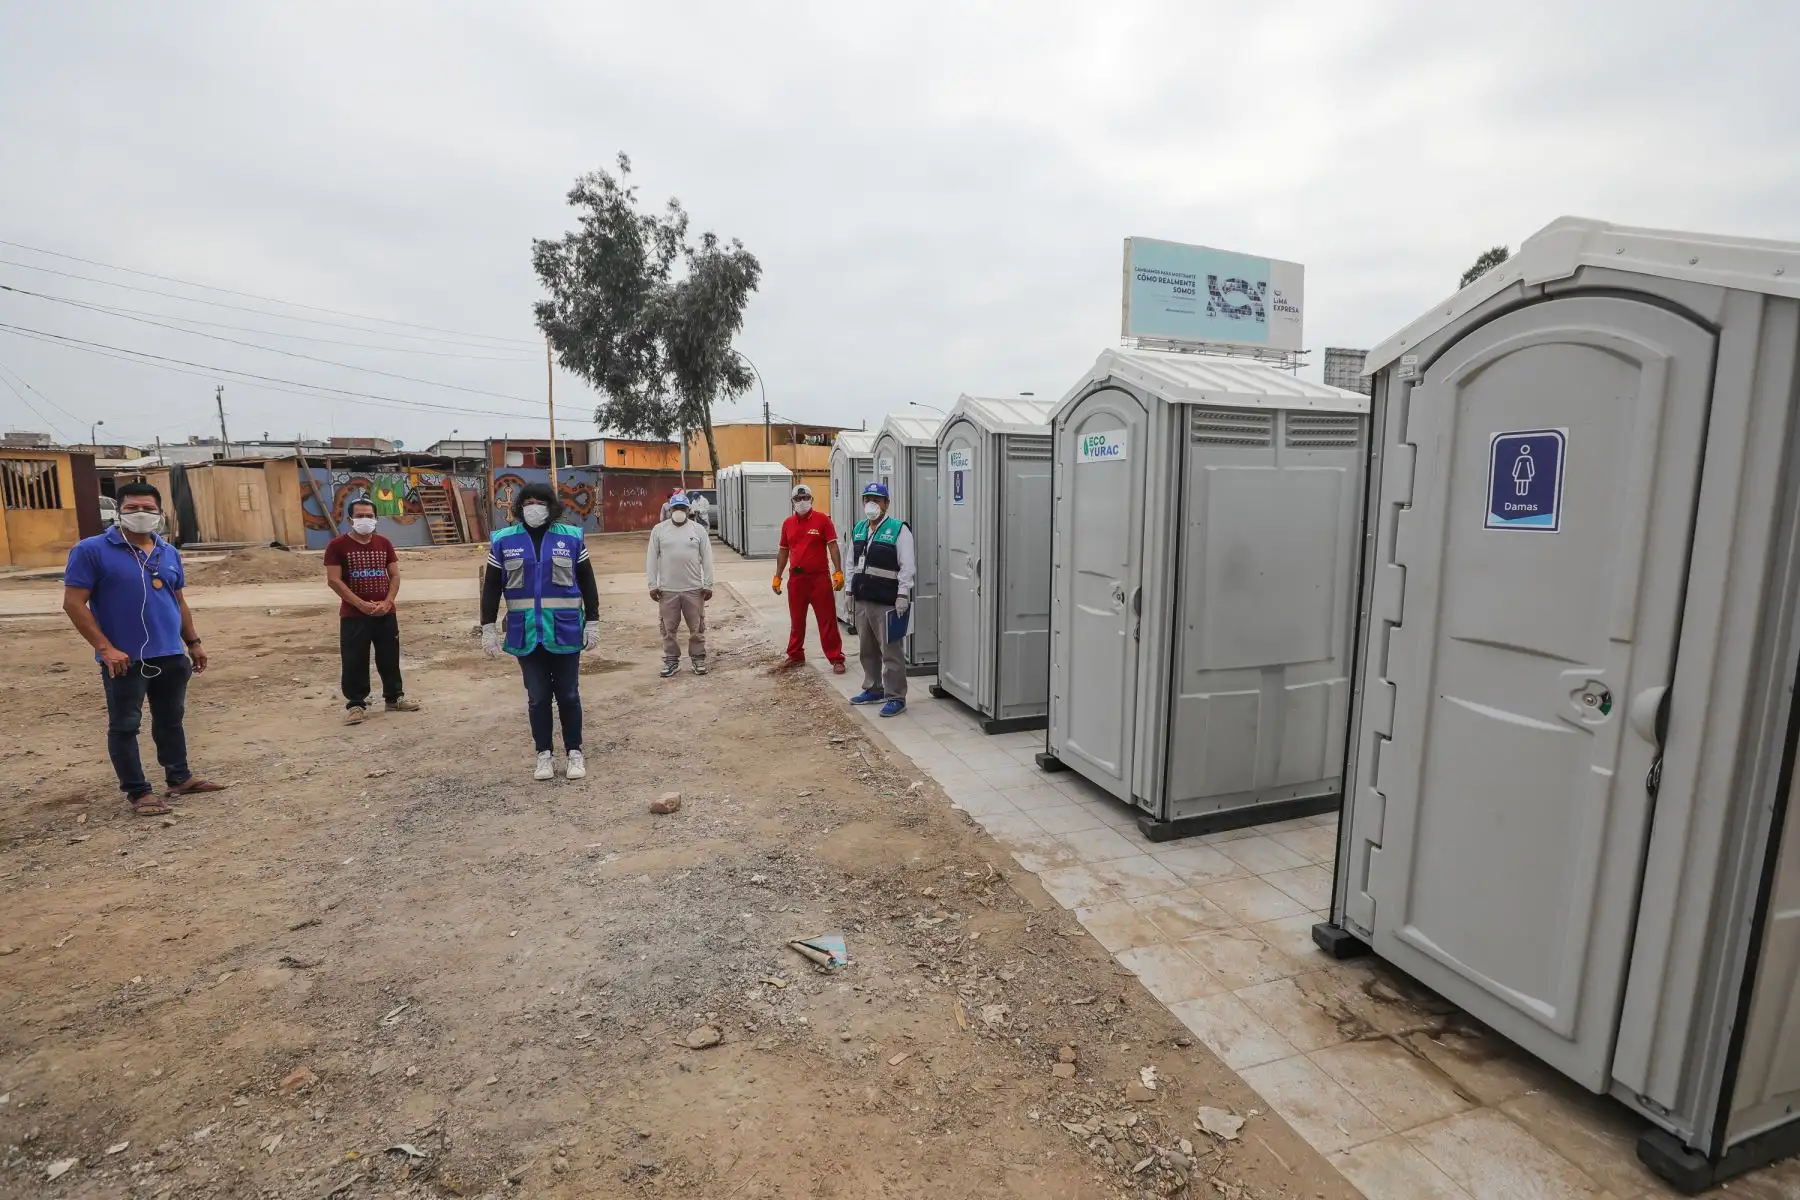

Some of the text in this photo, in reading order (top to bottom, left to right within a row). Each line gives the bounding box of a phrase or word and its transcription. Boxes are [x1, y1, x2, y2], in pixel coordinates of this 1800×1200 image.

[1137, 273, 1195, 287] CÓMO REALMENTE
[1172, 287, 1195, 295] SOMOS
[1273, 304, 1300, 314] EXPRESA
[1089, 435, 1105, 446] ECO
[1090, 445, 1119, 457] YURAC
[1504, 502, 1538, 511] Damas
